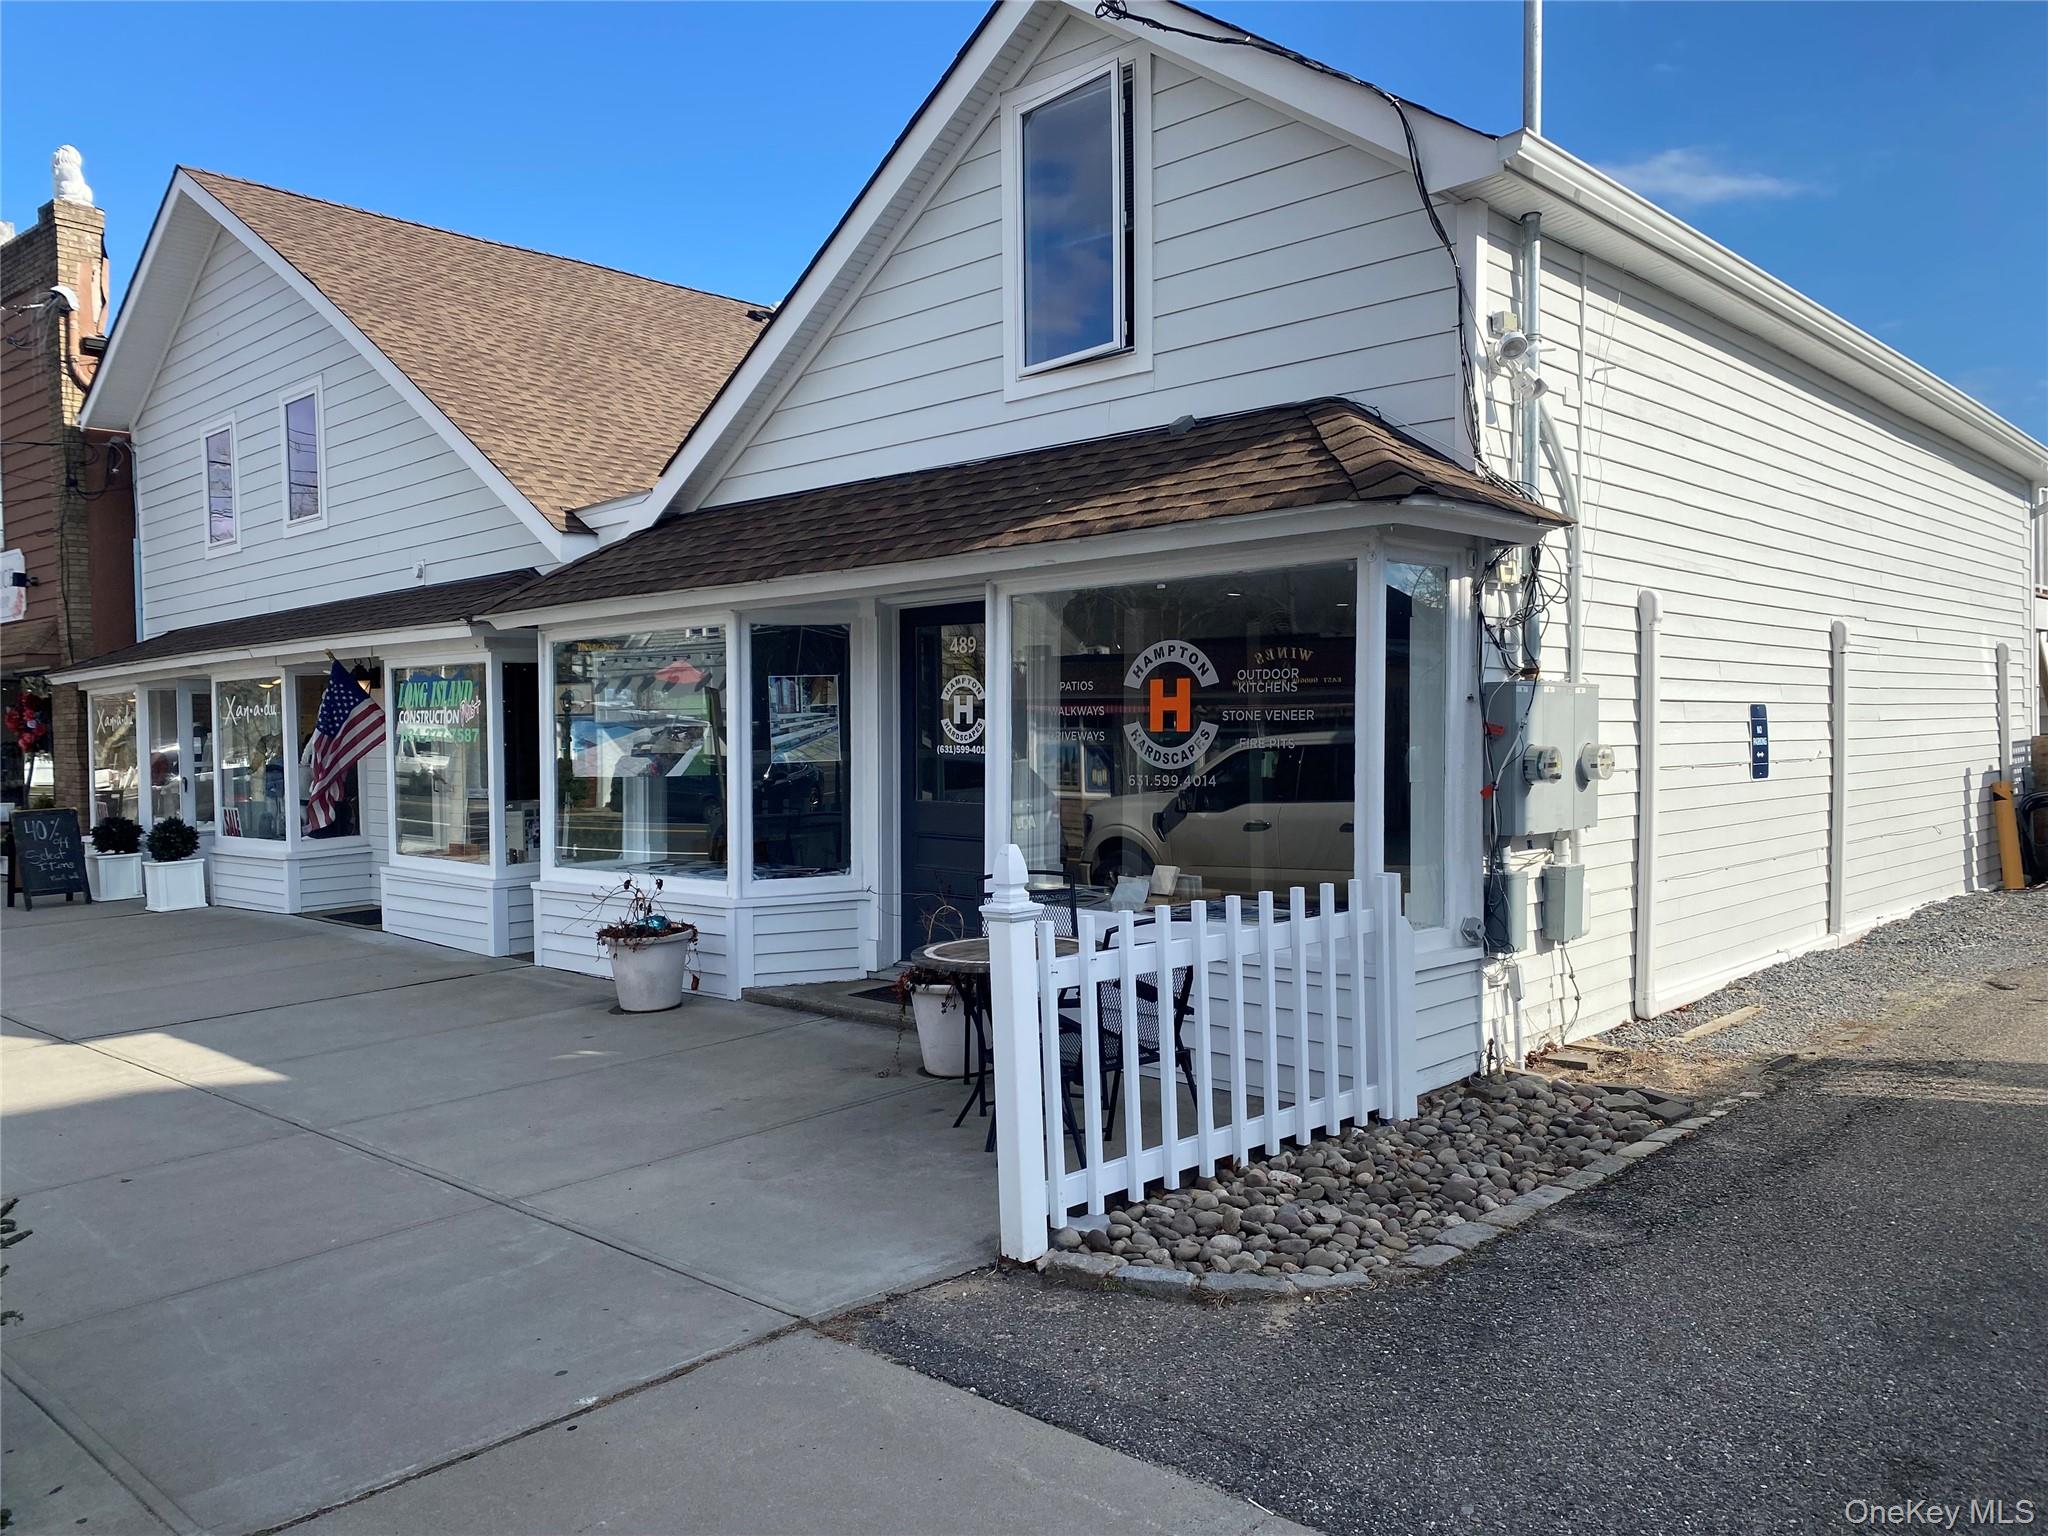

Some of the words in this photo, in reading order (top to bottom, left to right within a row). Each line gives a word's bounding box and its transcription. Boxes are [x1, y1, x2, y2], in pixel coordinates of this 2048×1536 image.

[950, 636, 976, 654] 489
[1132, 644, 1210, 679] HAMPTON
[1237, 667, 1300, 680] OUTDOOR
[397, 682, 429, 709] LONG
[429, 679, 474, 708] ISLAND
[944, 677, 983, 696] HAMPTON
[1059, 680, 1094, 691] PATIOS
[1238, 681, 1298, 693] KITCHENS
[953, 694, 974, 725] H
[1149, 677, 1191, 733] H
[398, 708, 460, 724] CONSTRUCTION
[1222, 709, 1262, 721] STONE
[1265, 709, 1315, 721] VENEER
[944, 721, 984, 741] HARDSCAPES
[936, 744, 985, 755] (631)599-401
[1131, 728, 1211, 765] HARDSCAPES
[1239, 737, 1266, 749] FIRE
[1269, 737, 1296, 749] PITS
[1128, 774, 1217, 787] 631.599.4014
[24, 817, 60, 841] 40%
